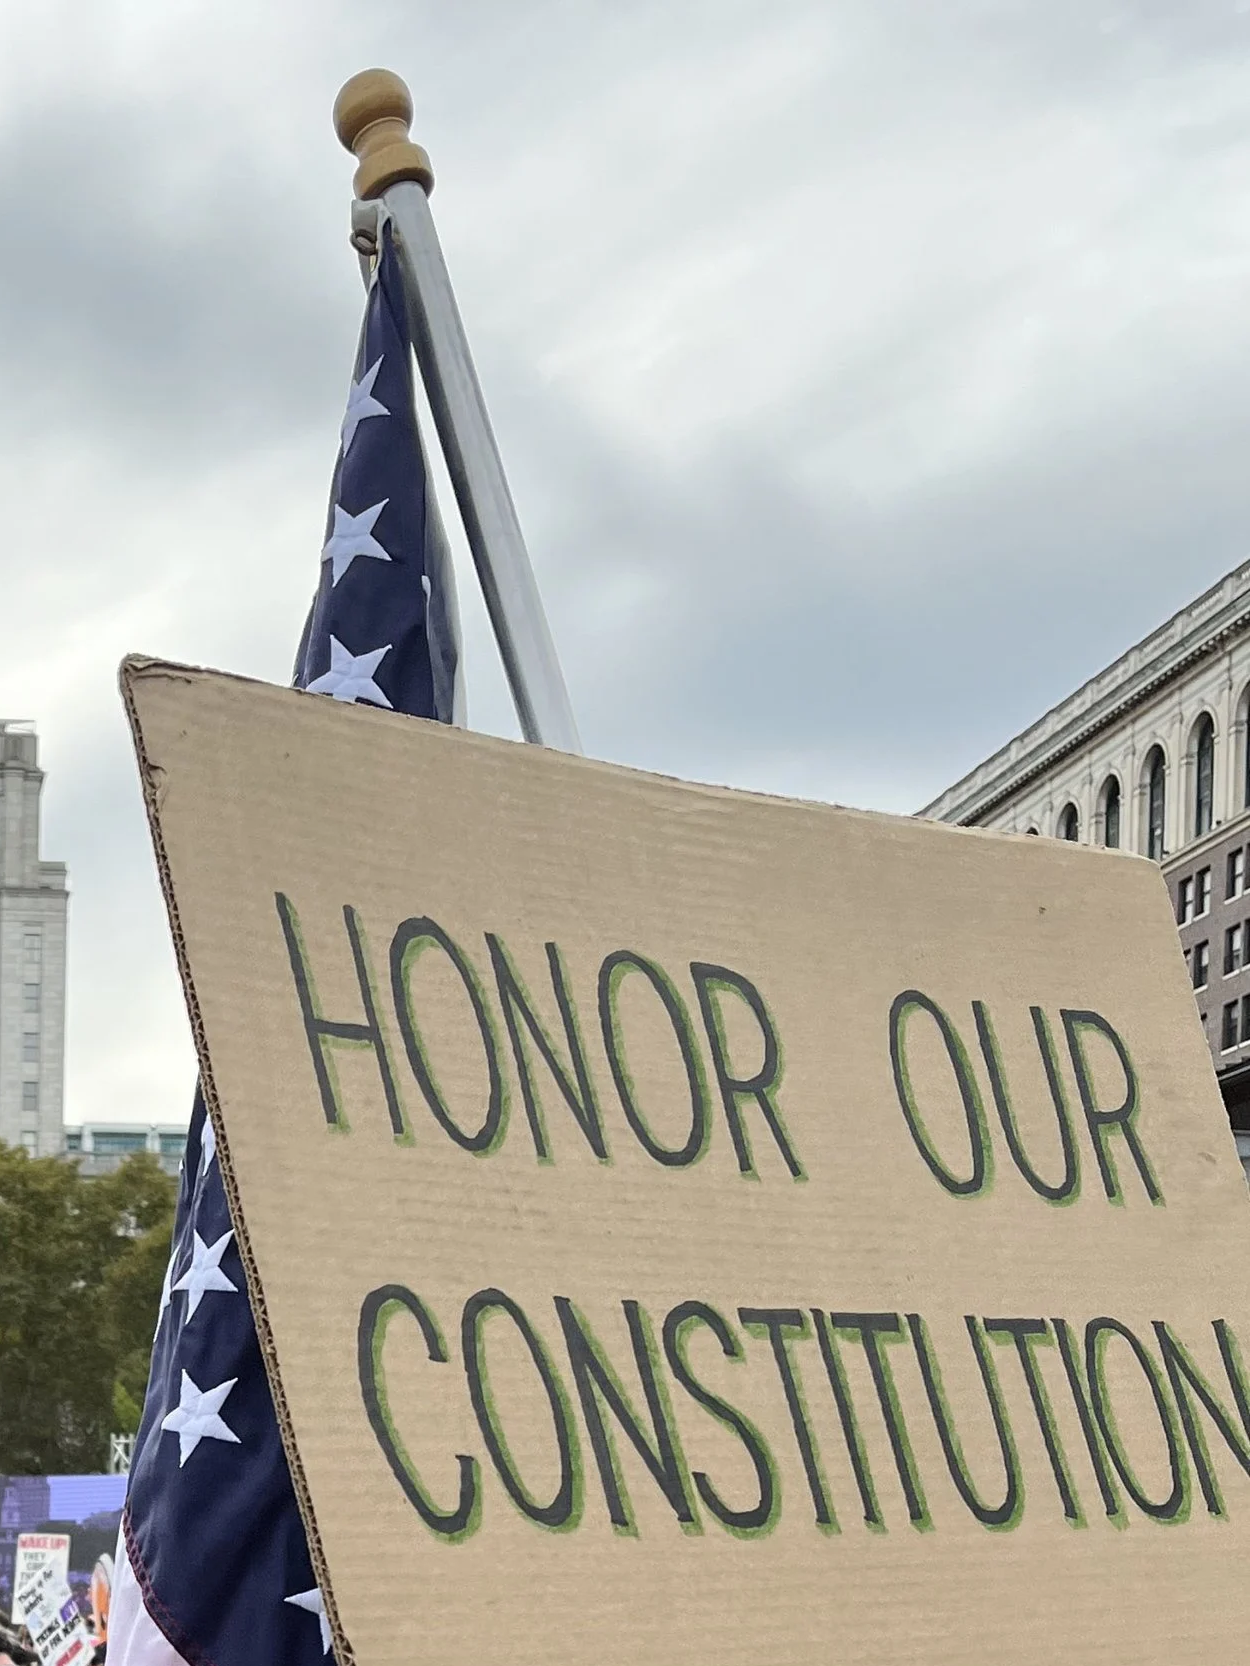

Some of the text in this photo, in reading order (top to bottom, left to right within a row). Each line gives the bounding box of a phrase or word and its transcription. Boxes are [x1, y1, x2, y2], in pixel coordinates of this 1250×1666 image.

[274, 891, 1165, 1208] HONOR OUR
[19, 1537, 48, 1550] WAKE
[358, 1283, 1250, 1545] CONSTITUTION
